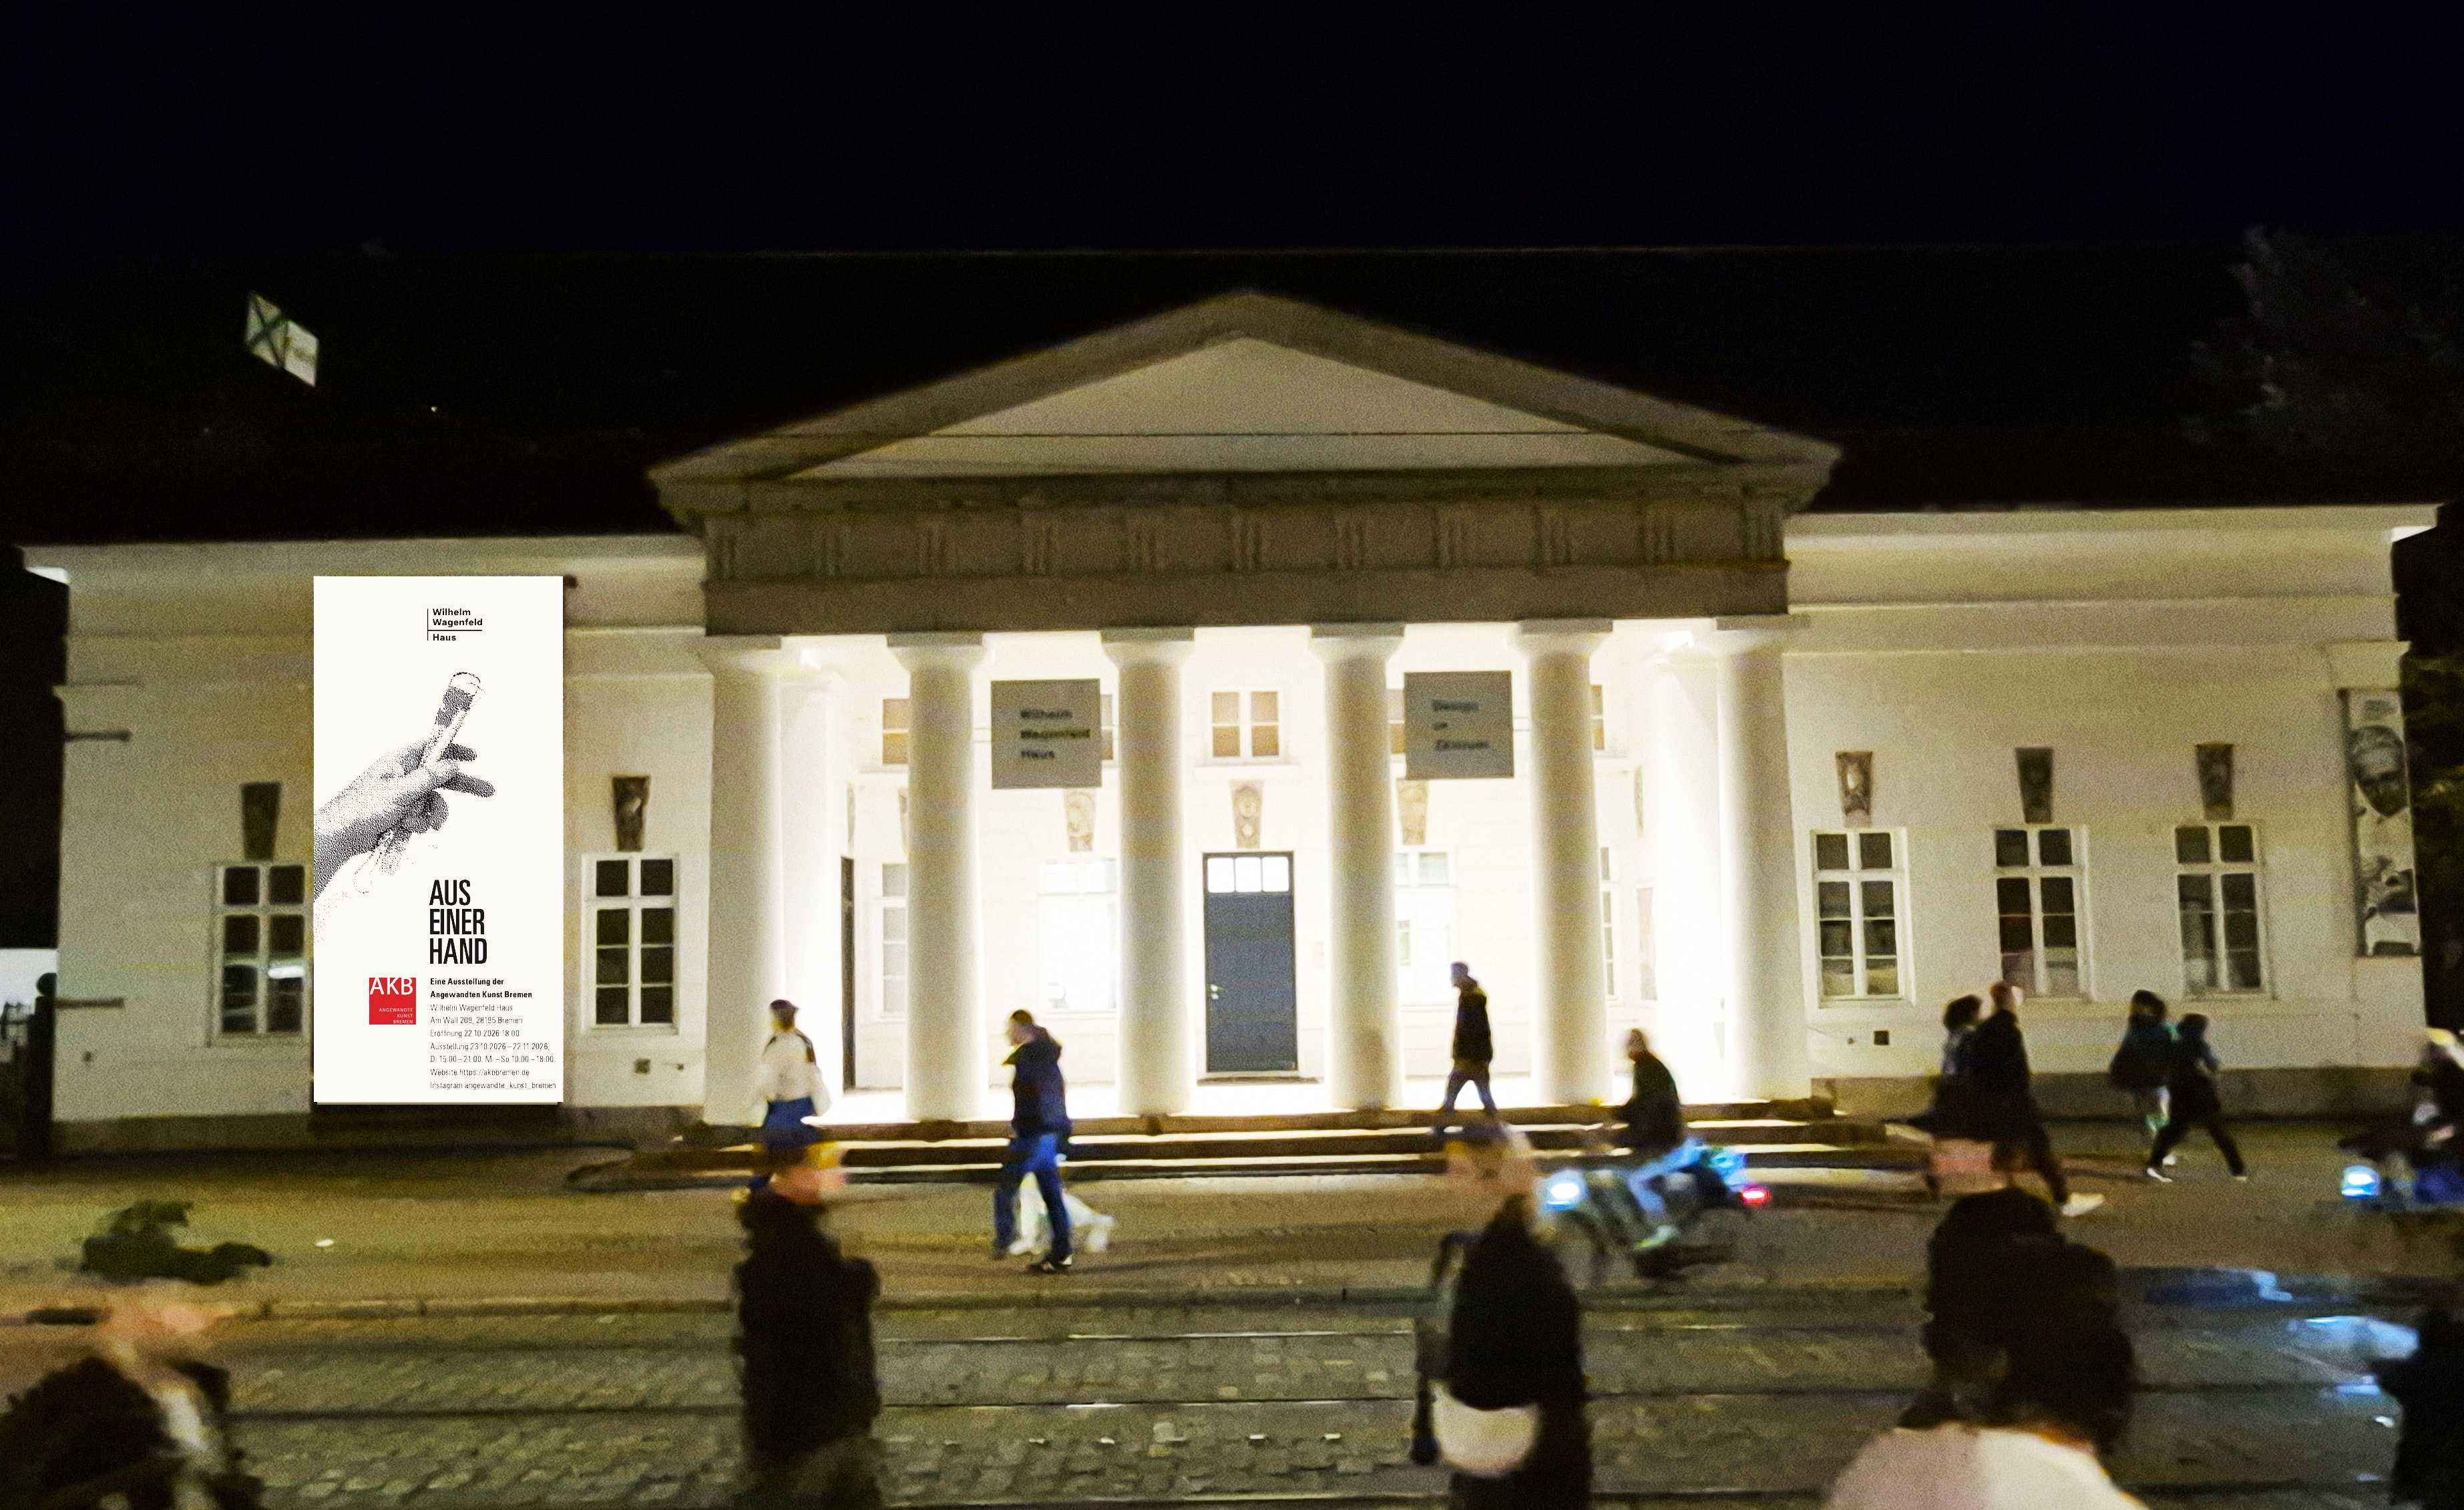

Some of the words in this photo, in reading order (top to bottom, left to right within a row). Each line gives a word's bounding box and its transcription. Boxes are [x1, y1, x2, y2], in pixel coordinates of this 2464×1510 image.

[433, 608, 471, 616] Wilhelm
[433, 618, 483, 628] Wagenfeld
[433, 633, 457, 641] Haus
[429, 879, 471, 906] AUS
[430, 908, 485, 935] EINER
[430, 938, 487, 964] HAND
[370, 977, 413, 995] AKB
[447, 978, 490, 986] Ausstellung
[430, 991, 480, 1000] Angewandten
[430, 1004, 457, 1012] Wilhelm
[459, 1004, 495, 1012] Wagenfeld
[497, 1004, 513, 1012] Haus
[430, 1016, 441, 1024] Am
[443, 1016, 458, 1024] Wall
[476, 1016, 496, 1024] 28195
[498, 1016, 523, 1024] Bremen
[431, 1029, 462, 1039] Eröffnung
[464, 1029, 500, 1038] 22.10.2026
[502, 1029, 520, 1038] 18:00
[430, 1043, 469, 1052] Ausstellung
[430, 1055, 437, 1063] Di
[459, 1069, 530, 1077] https://akbbremen.de
[430, 1081, 463, 1091] Instagram
[465, 1081, 557, 1091] angewandte_kunst_bremen
